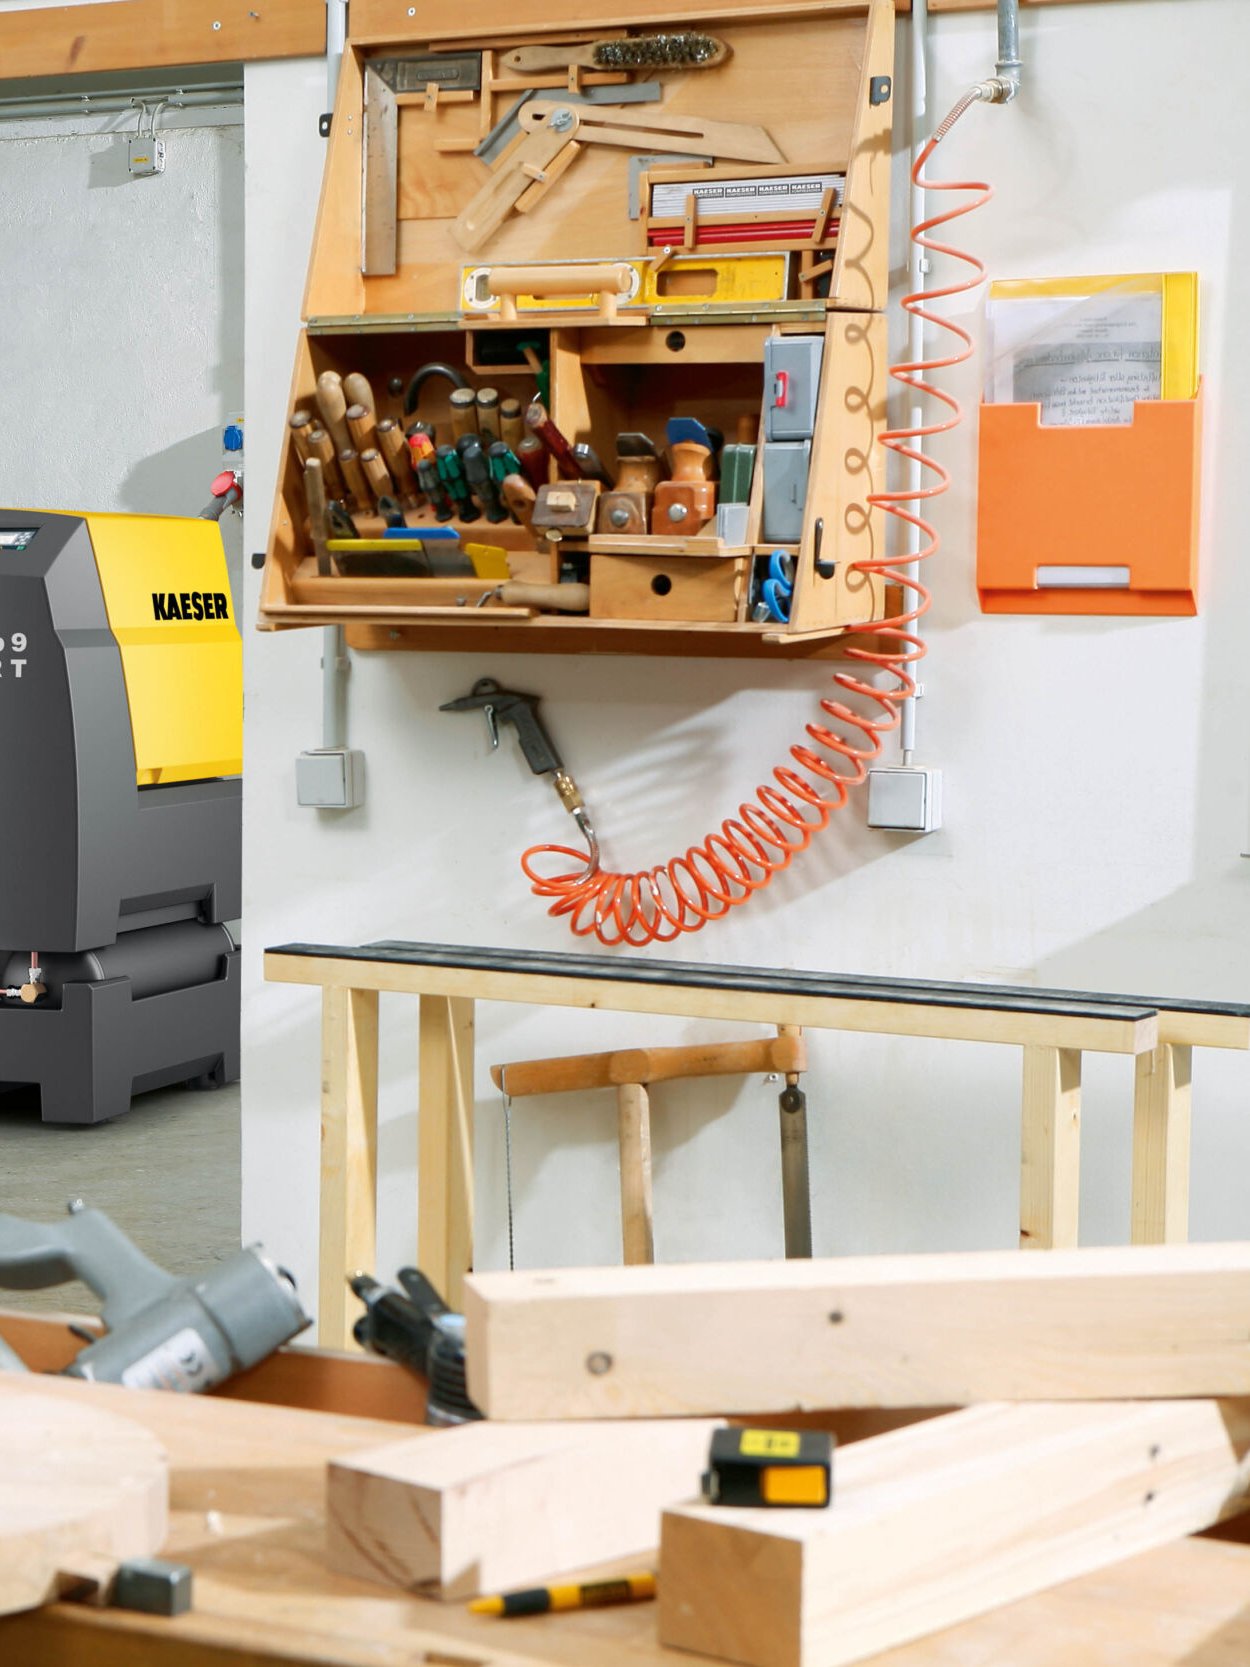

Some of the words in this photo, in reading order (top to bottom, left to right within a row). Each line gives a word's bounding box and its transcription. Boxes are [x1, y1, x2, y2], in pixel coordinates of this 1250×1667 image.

[152, 592, 229, 621] KAESER
[11, 632, 27, 652] 9
[10, 659, 27, 678] T
